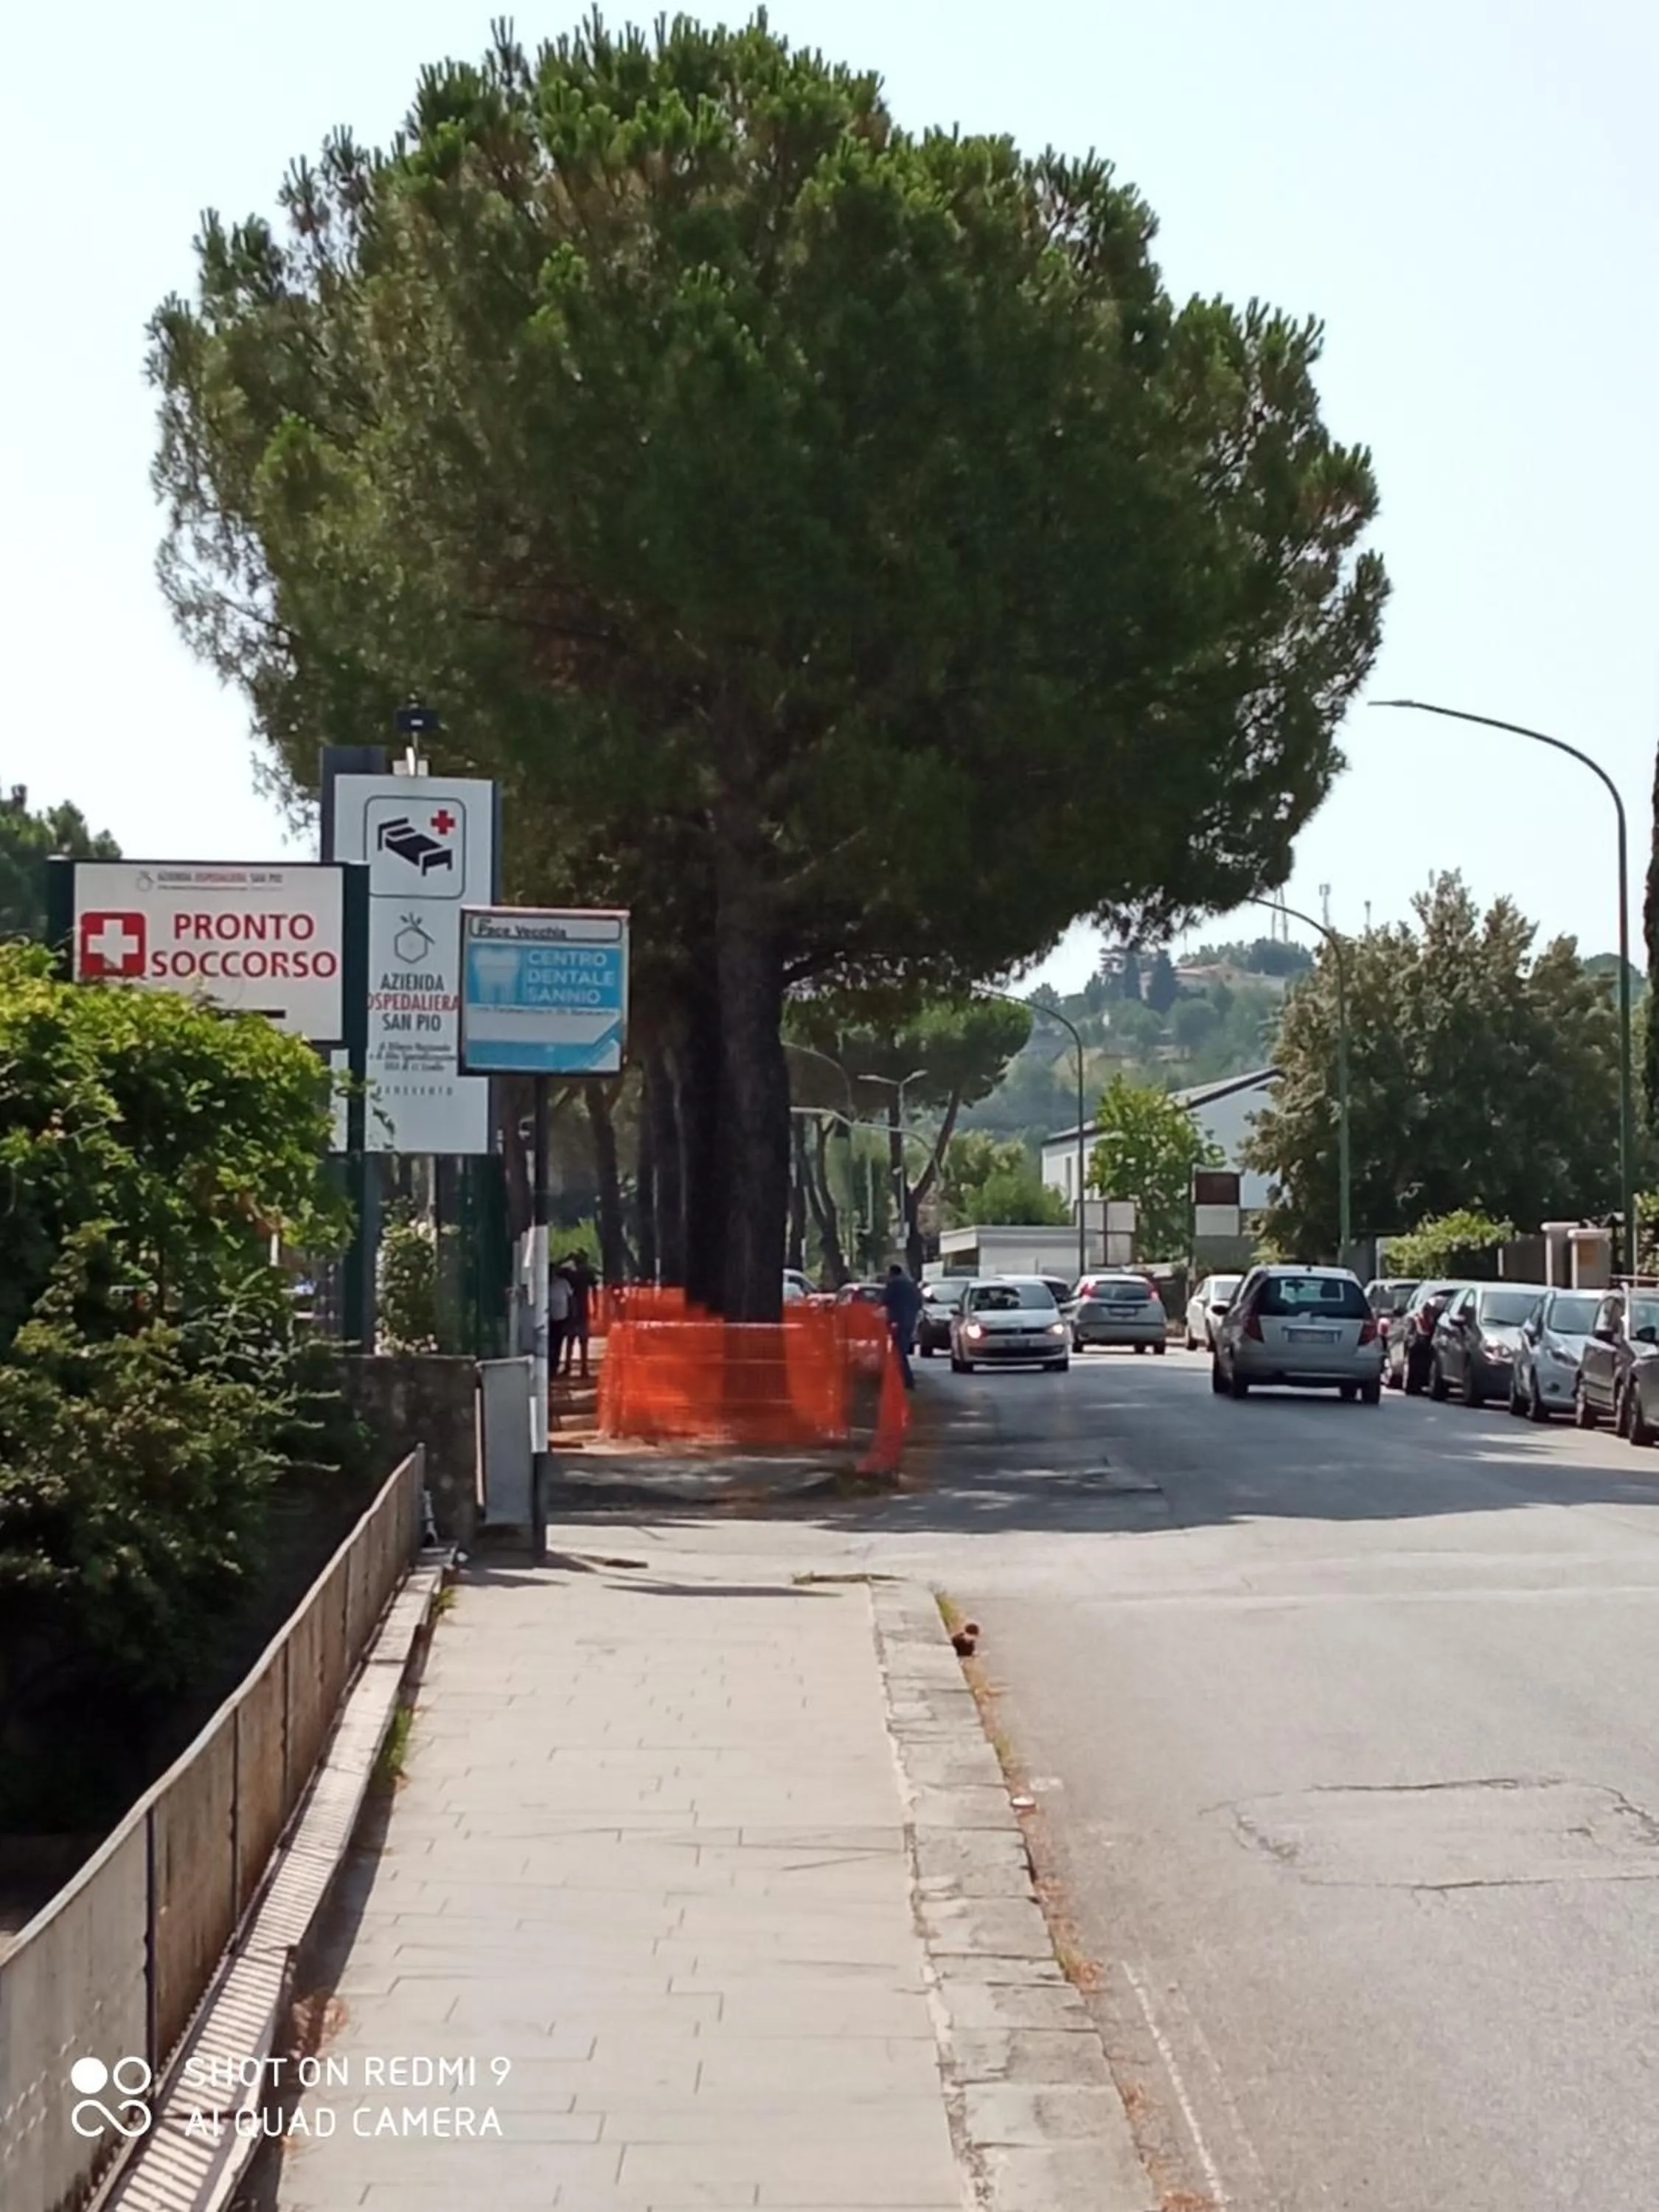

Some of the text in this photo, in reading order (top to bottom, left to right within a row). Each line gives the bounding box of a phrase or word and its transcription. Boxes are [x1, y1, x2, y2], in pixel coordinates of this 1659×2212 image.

[173, 913, 314, 941] PRONTO
[151, 950, 338, 978] SOCCORSO
[528, 950, 607, 967] CENTRO
[380, 973, 445, 992] AZIENDA
[528, 969, 616, 987] DENTALE
[528, 987, 602, 1004] SANNIO
[382, 1012, 442, 1032] SAN PIO
